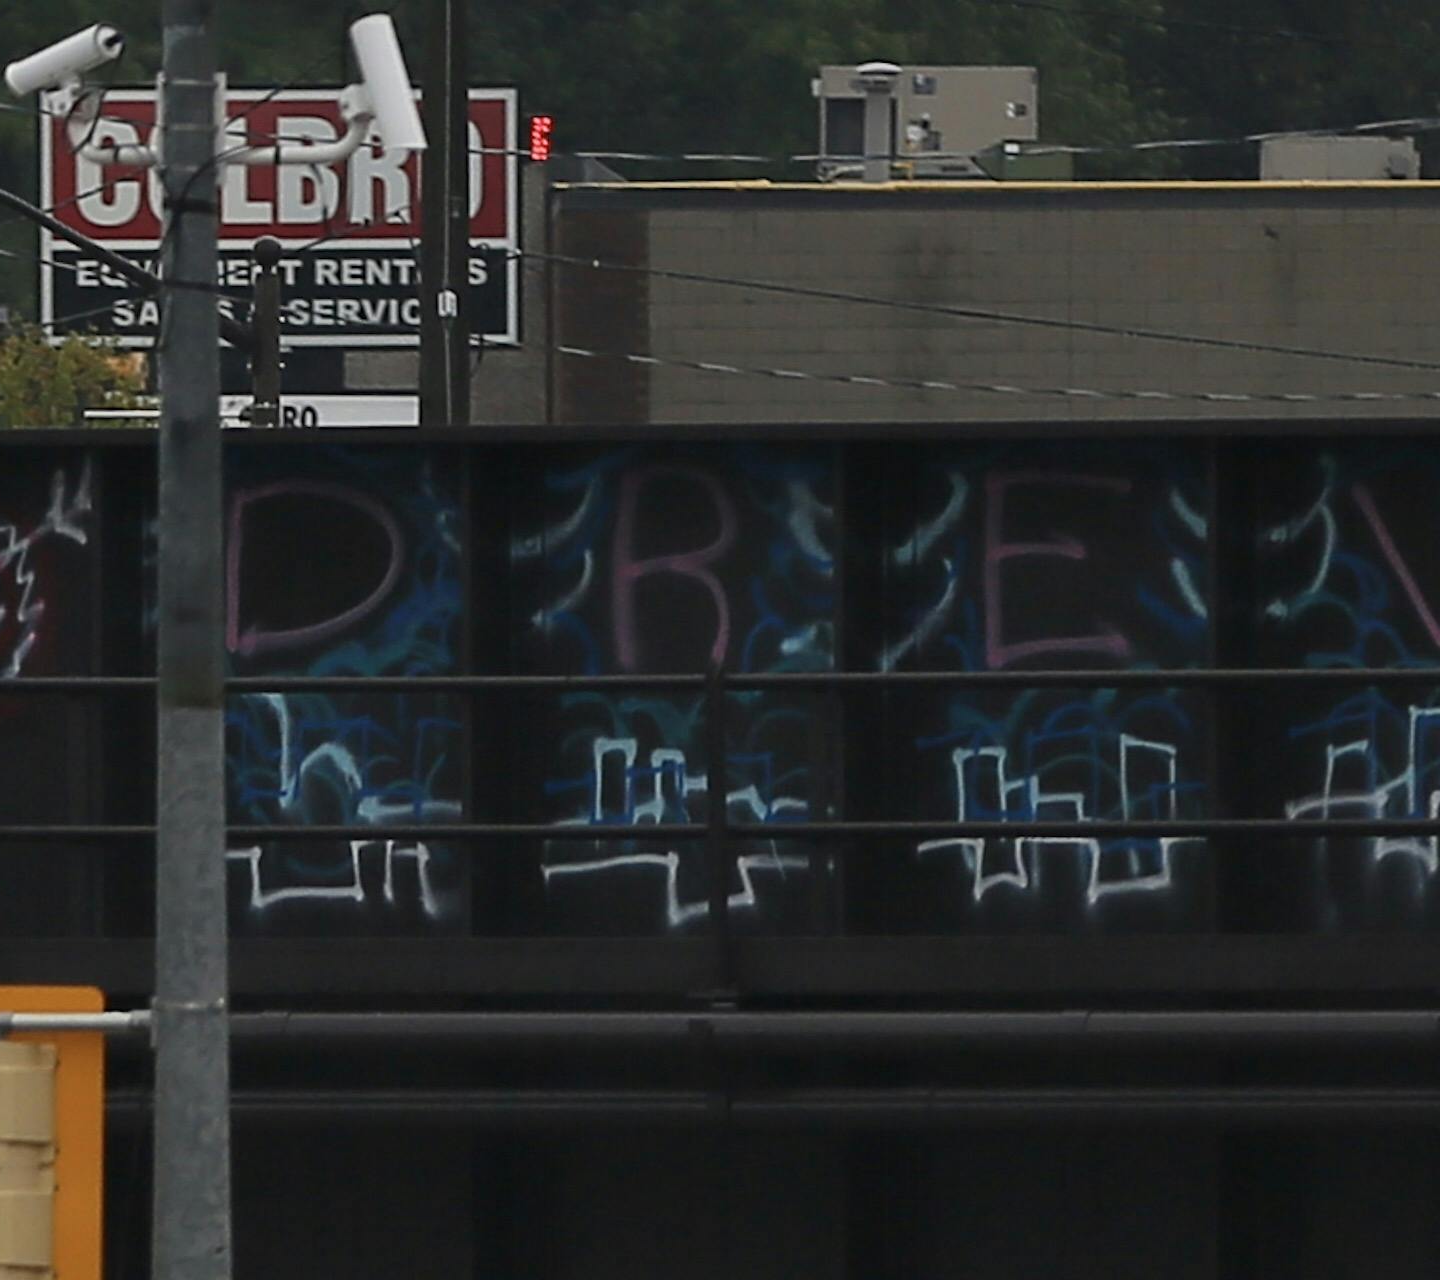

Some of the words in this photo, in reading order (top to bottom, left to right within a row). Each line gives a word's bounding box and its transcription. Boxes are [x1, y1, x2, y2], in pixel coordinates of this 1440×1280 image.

[76, 115, 484, 226] CLBR
[314, 258, 488, 287] RENTS
[287, 298, 422, 326] SERVIC
